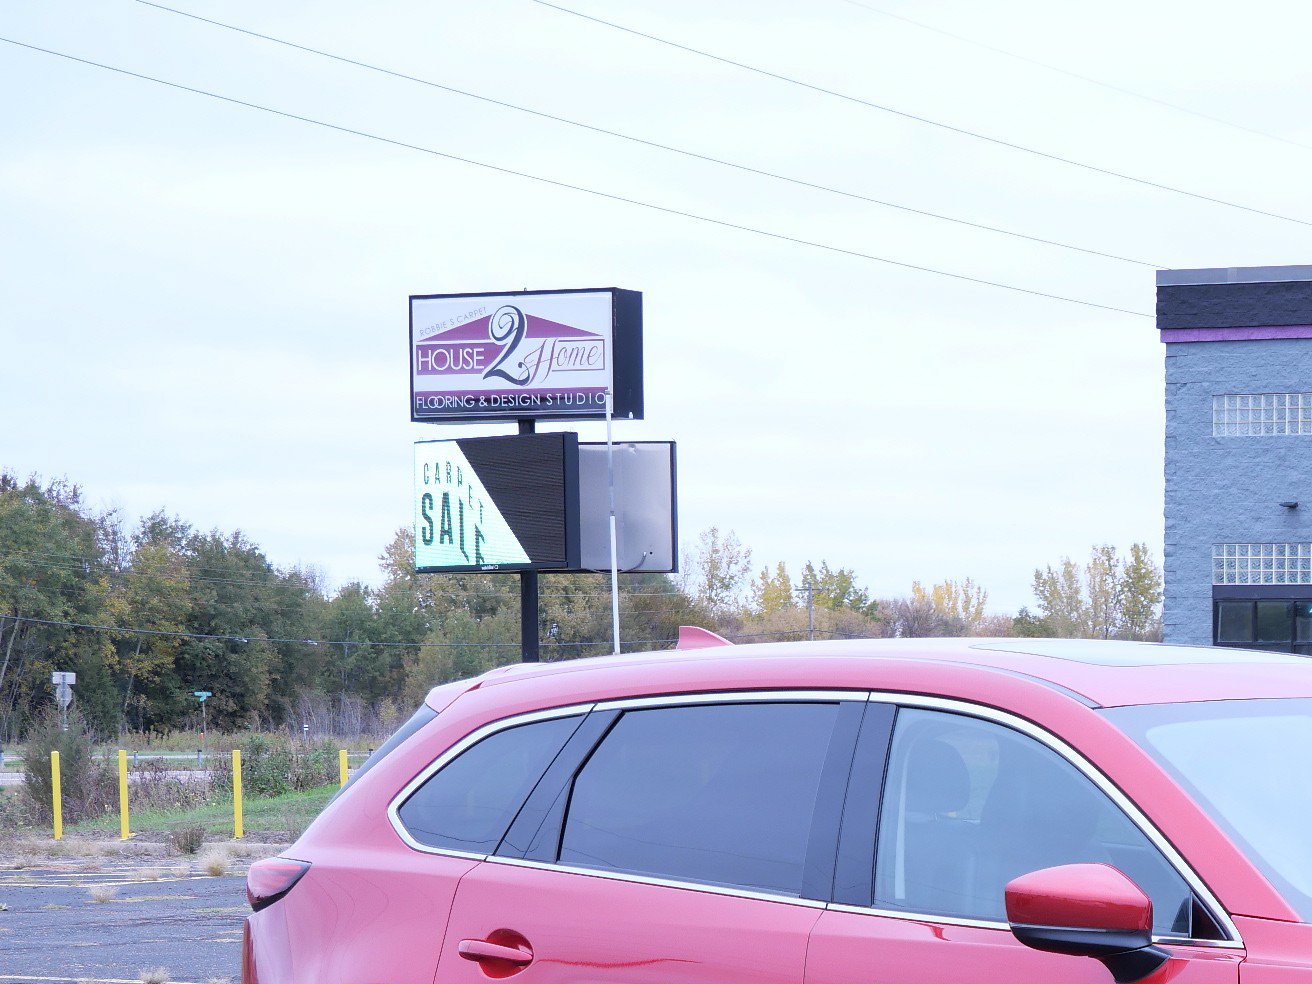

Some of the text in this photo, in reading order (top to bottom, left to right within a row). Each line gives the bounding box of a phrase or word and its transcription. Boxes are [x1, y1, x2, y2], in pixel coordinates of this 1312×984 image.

[419, 306, 488, 337] ROBBIES CARPET
[417, 347, 485, 371] HOUSE
[483, 304, 530, 386] 2
[518, 338, 602, 386] Home
[416, 392, 606, 409] FLOORING & DESIGN STUDIO
